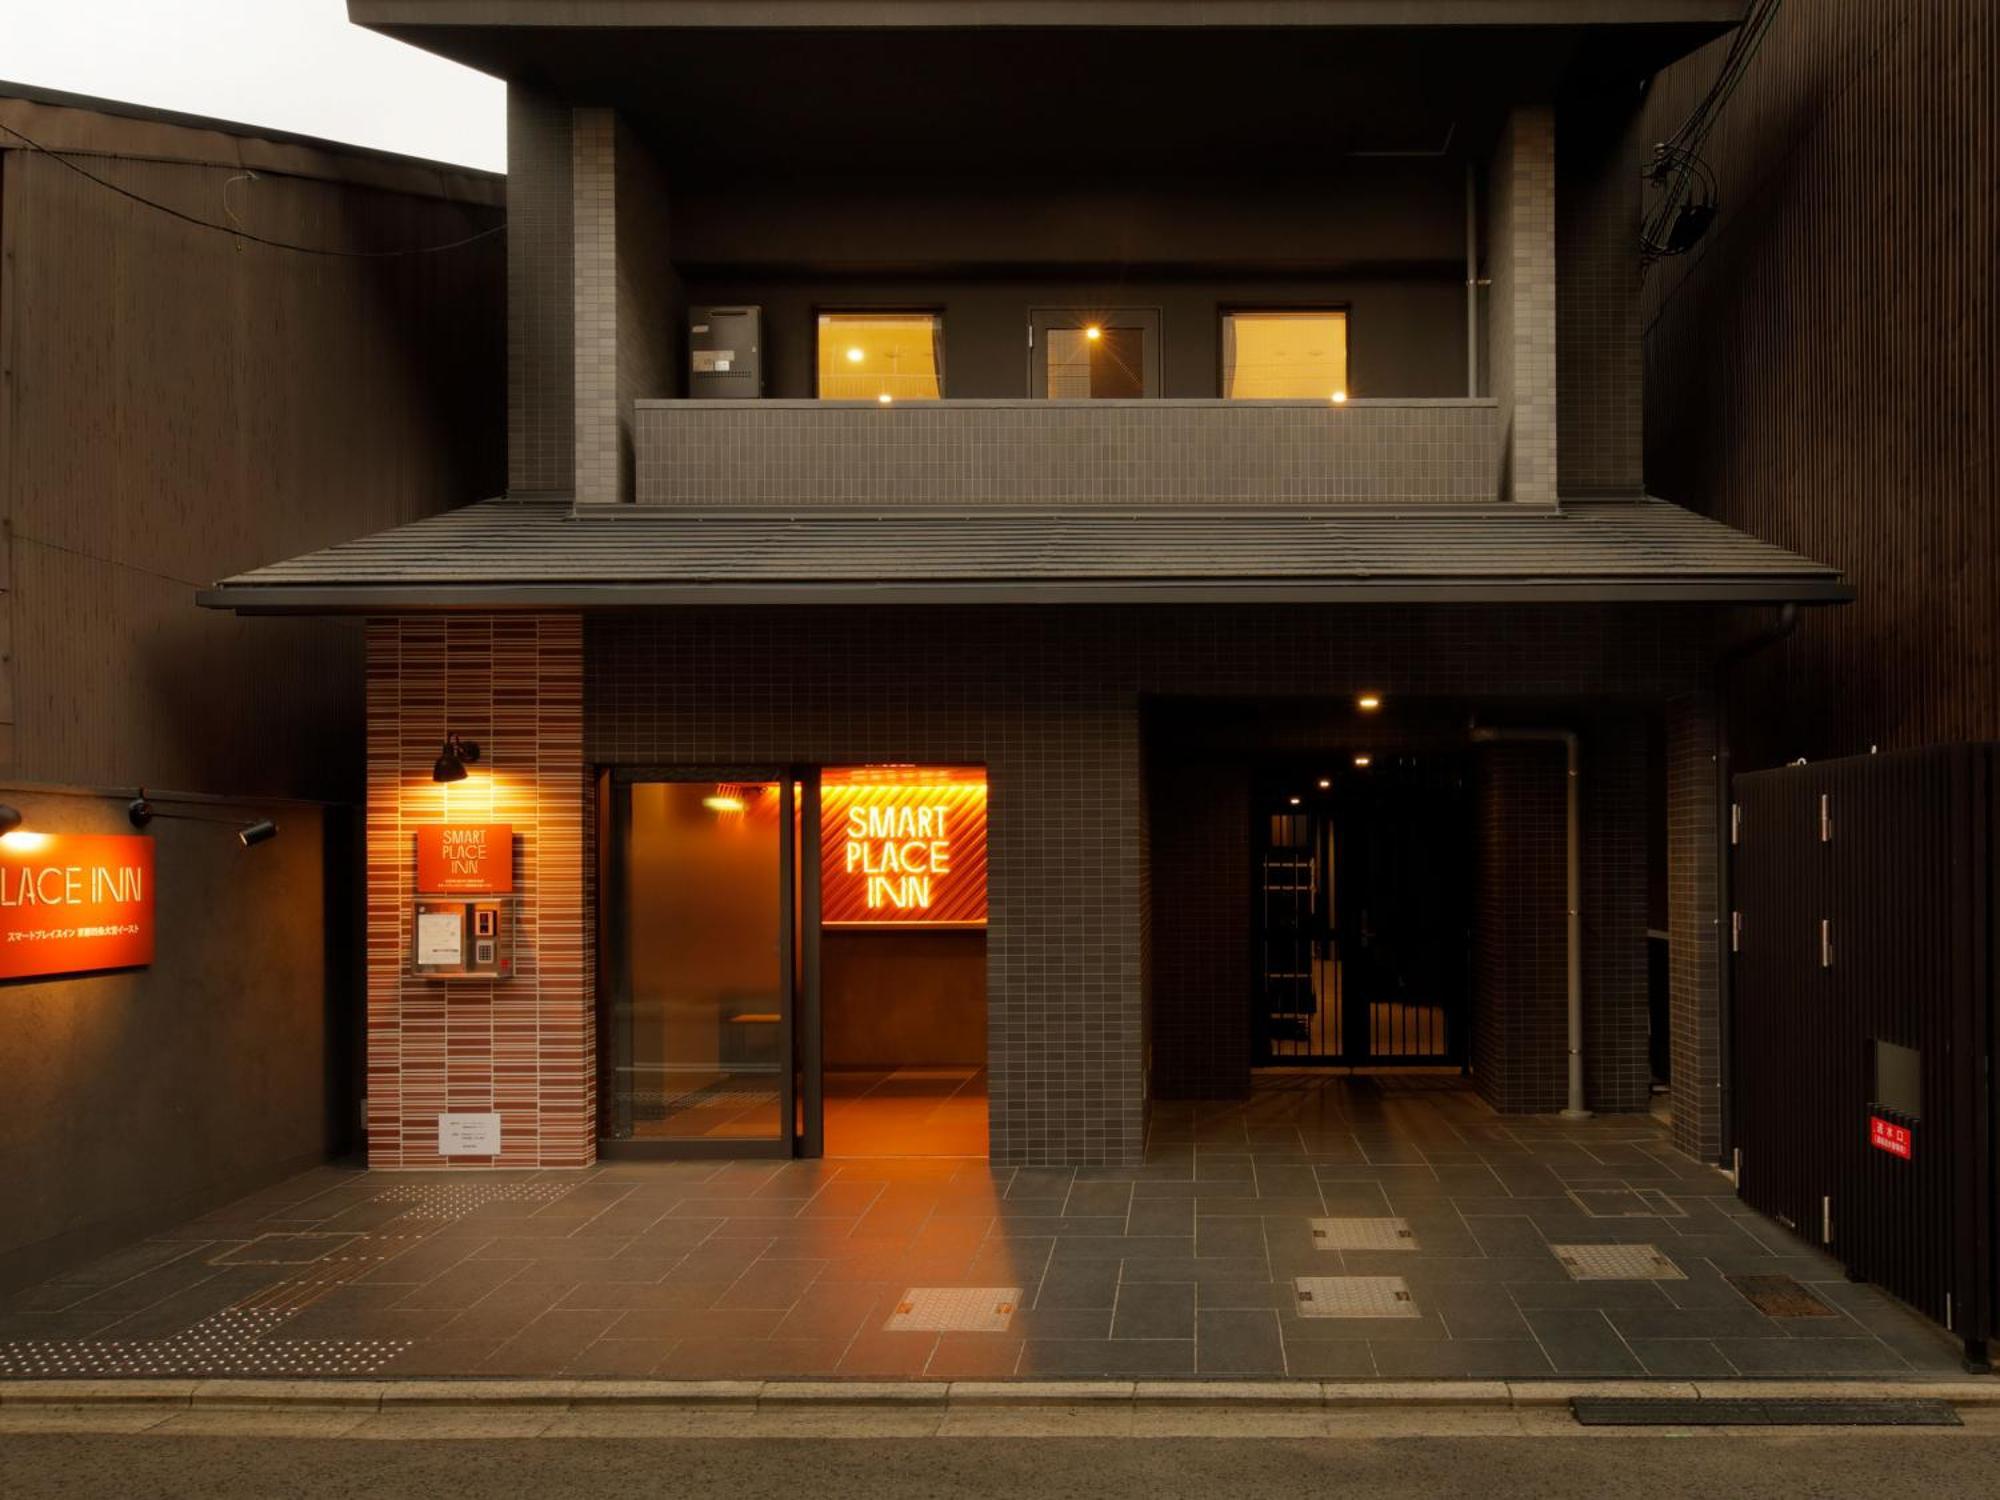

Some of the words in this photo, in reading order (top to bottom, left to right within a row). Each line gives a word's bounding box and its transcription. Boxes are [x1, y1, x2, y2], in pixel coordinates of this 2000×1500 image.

[442, 830, 487, 845] SMART
[847, 805, 949, 838] SMART
[442, 844, 488, 860] PLACE
[451, 860, 479, 874] INN
[846, 841, 950, 874] PLACE
[0, 867, 82, 906] LACE
[91, 866, 142, 904] INN
[867, 876, 930, 909] INN
